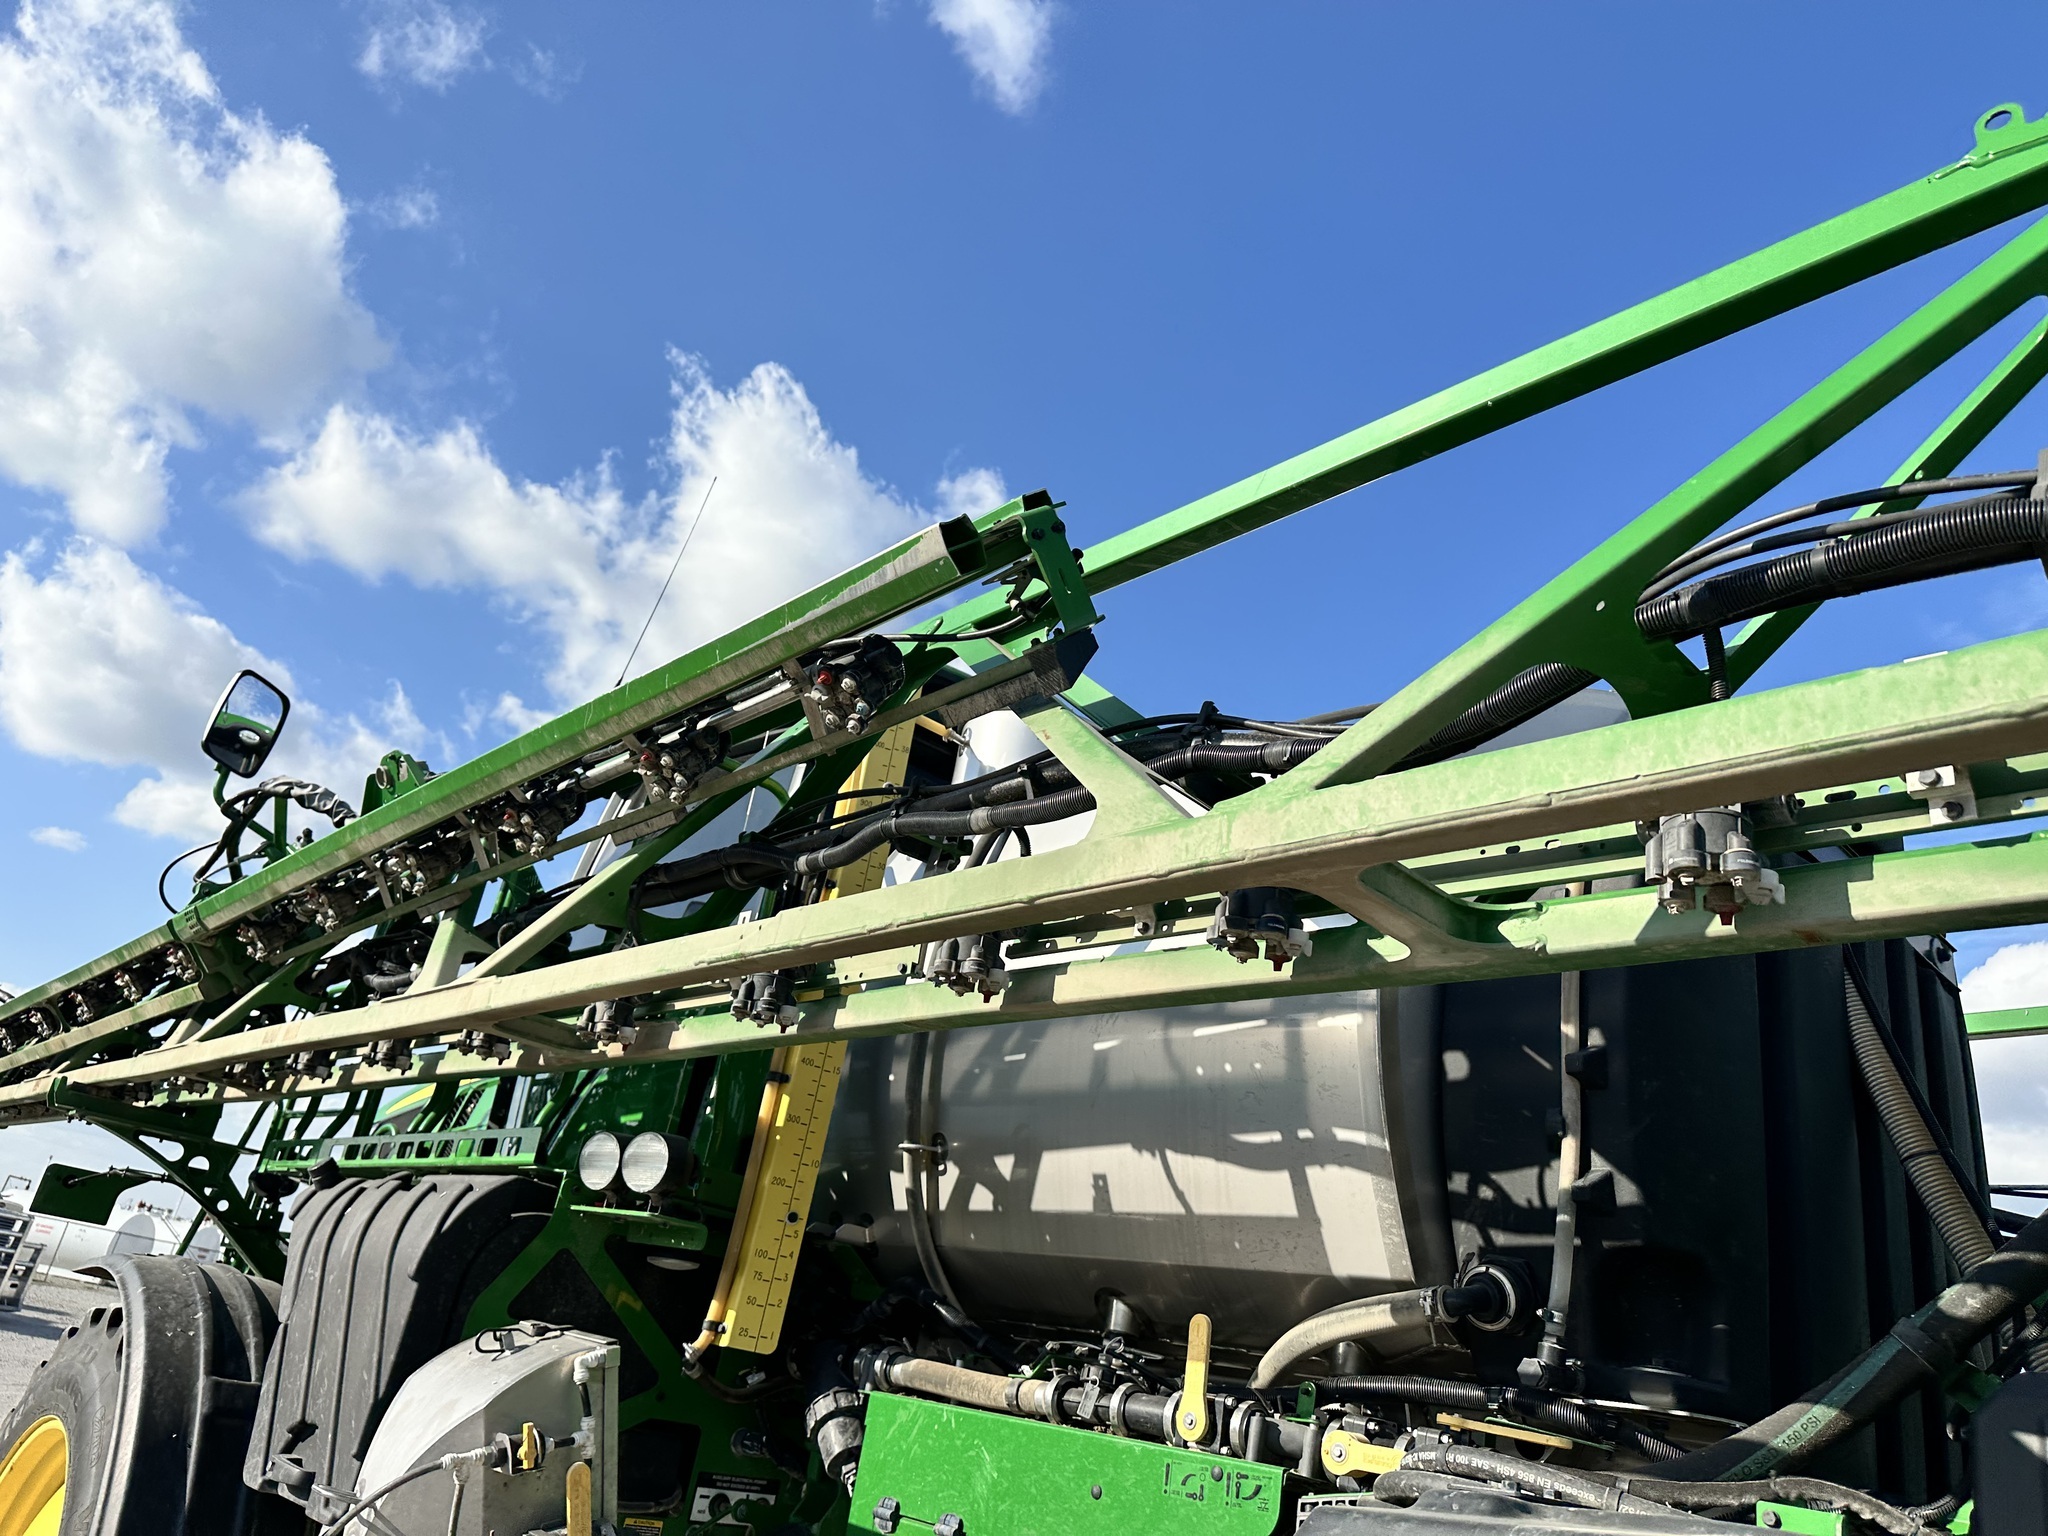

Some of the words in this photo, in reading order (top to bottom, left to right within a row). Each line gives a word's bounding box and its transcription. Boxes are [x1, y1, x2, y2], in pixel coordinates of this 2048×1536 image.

[801, 1058, 815, 1067] 400
[832, 1066, 841, 1075] 15
[786, 1114, 801, 1124] 300
[810, 1159, 820, 1169] 10
[771, 1176, 786, 1187] 200
[793, 1230, 799, 1239] 5
[754, 1249, 769, 1259] 100
[788, 1252, 794, 1260] 4
[753, 1271, 763, 1281] 75
[782, 1273, 789, 1282] 3
[746, 1296, 757, 1306] 50
[776, 1299, 783, 1308] 2
[738, 1327, 749, 1337] 25
[1781, 1431, 1802, 1449] 150
[1801, 1414, 1821, 1432] PSI
[1455, 1454, 1468, 1465] 100
[1471, 1457, 1490, 1470] SAE
[1496, 1465, 1516, 1479] 4SH
[1517, 1470, 1536, 1483] 856
[1536, 1475, 1552, 1489] EN
[1553, 1481, 1596, 1502] exceeds
